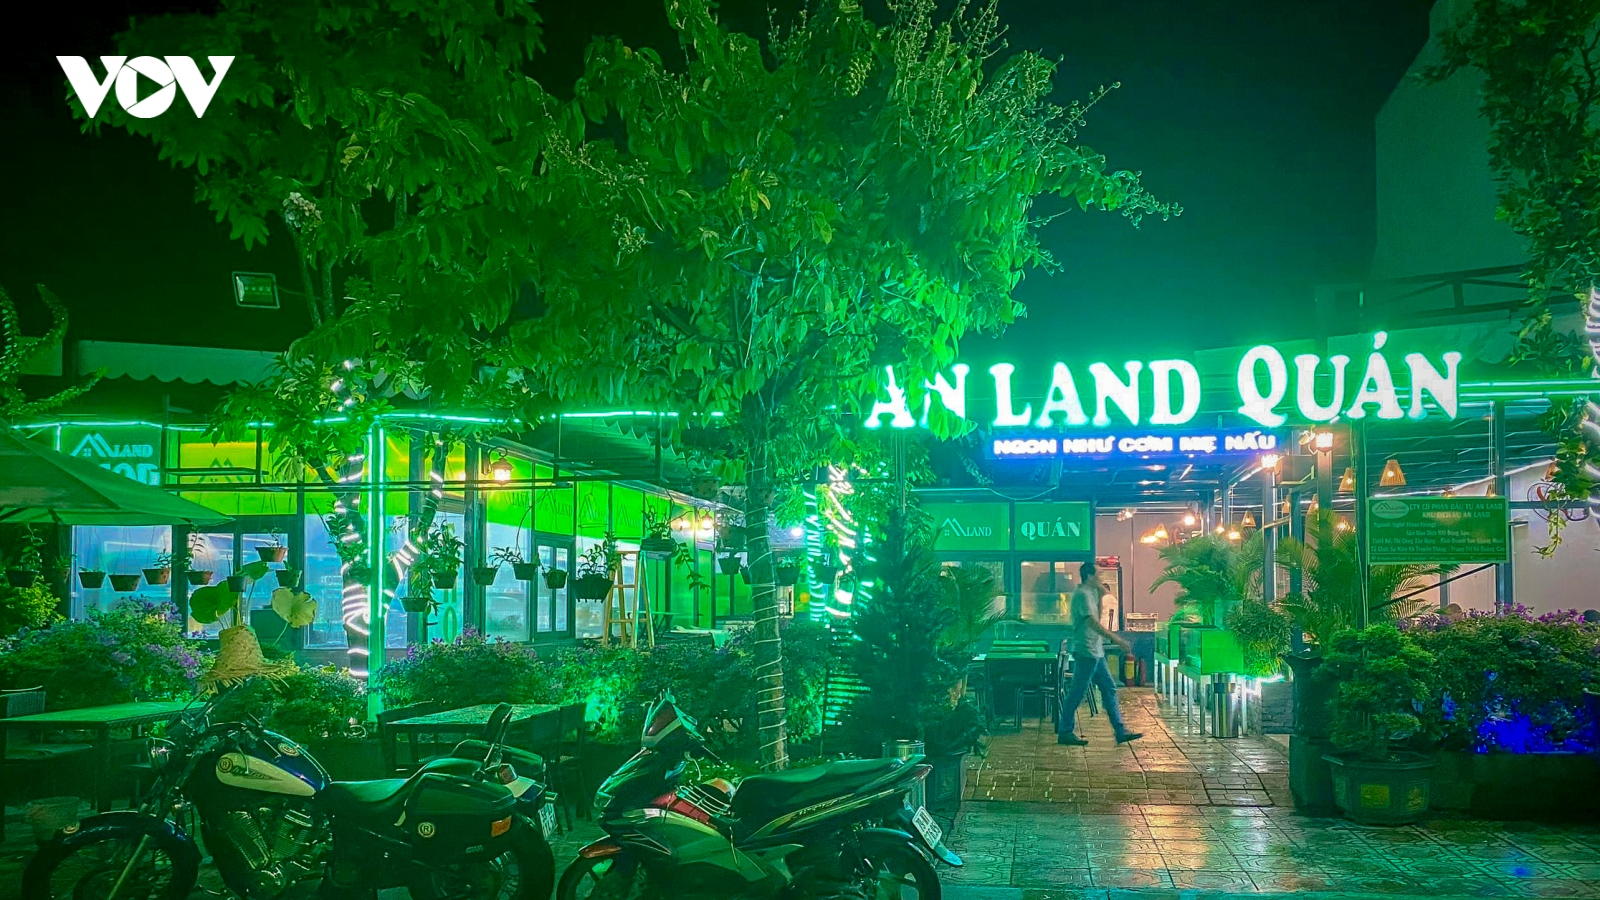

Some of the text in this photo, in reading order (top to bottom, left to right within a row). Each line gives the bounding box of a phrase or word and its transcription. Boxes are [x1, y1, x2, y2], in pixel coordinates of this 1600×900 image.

[864, 331, 1462, 428] AN LAND QUÁN
[113, 444, 153, 457] LAND
[993, 438, 1058, 455] NGON
[1062, 435, 1116, 454] NHƯ
[1117, 434, 1174, 454] CƠM
[1179, 435, 1217, 455] MẸ
[966, 516, 1082, 541] LAND QUÁN
